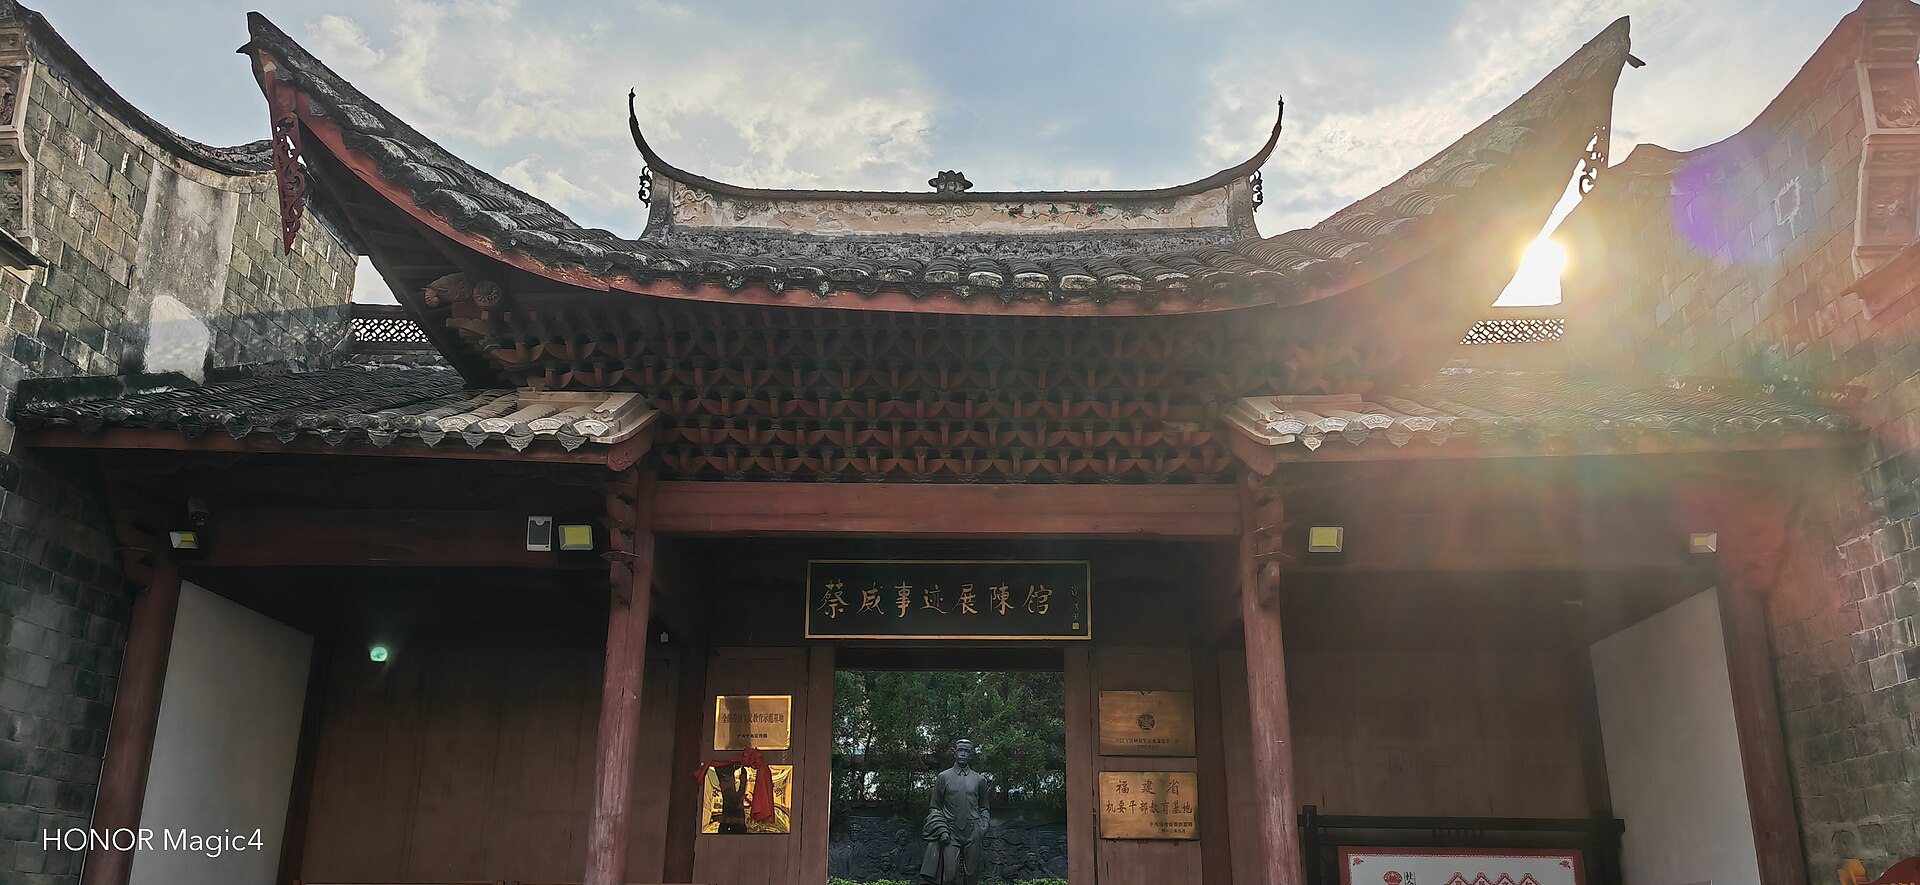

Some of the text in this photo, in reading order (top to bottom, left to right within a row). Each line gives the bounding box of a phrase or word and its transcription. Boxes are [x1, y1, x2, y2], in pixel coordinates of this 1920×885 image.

[1115, 778, 1181, 796] 福建省
[1105, 799, 1193, 815] 机要干部教育基地
